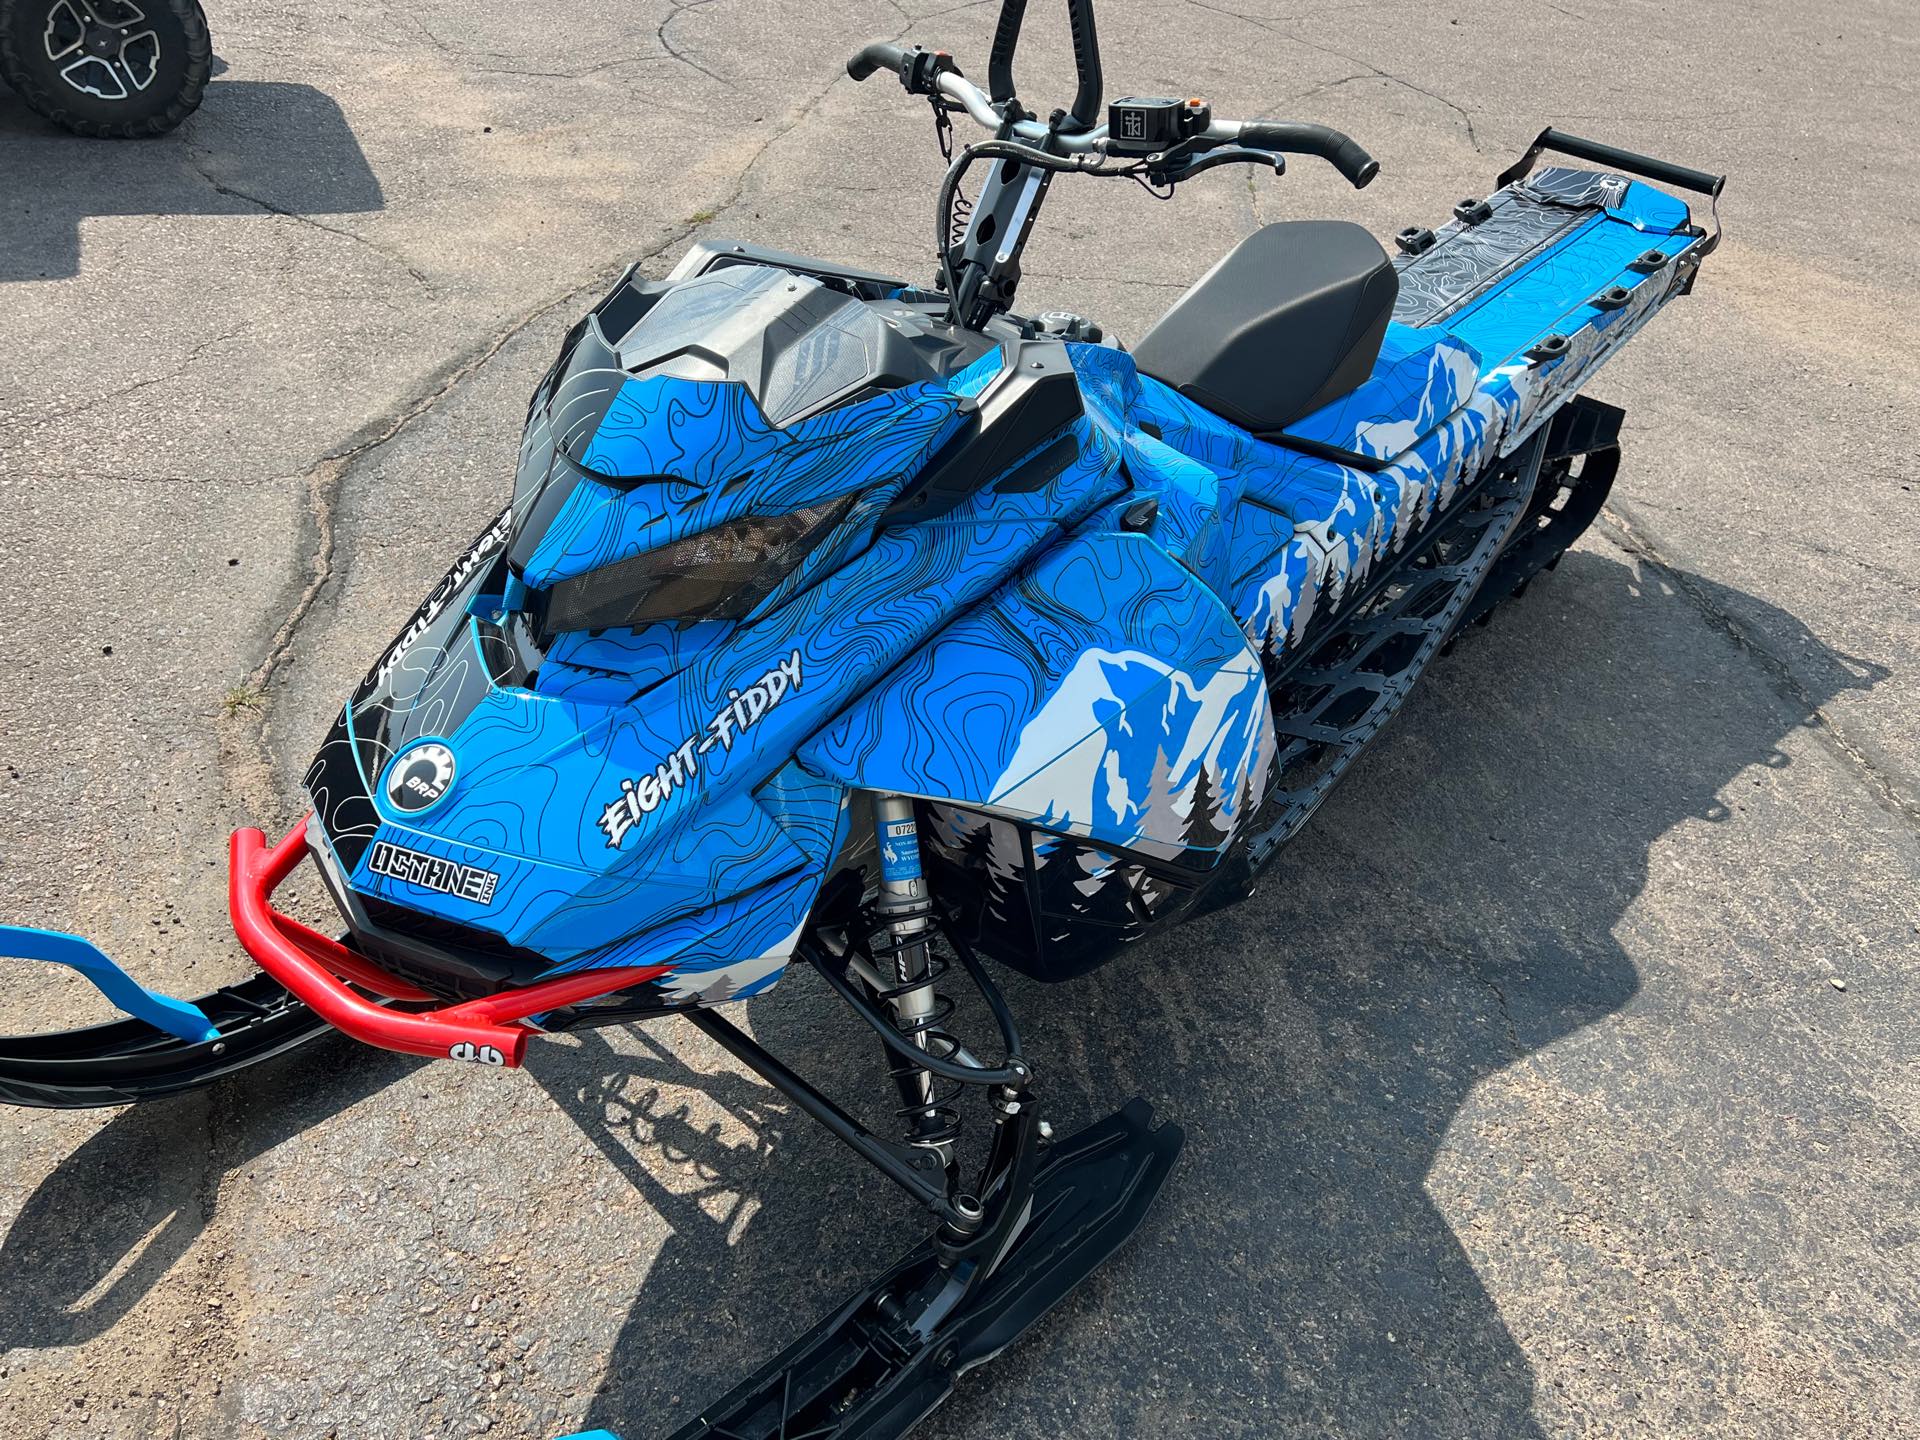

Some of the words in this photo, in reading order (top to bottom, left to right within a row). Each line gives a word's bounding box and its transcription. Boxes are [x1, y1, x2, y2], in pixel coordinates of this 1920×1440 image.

[405, 776, 439, 799] BRP
[369, 842, 487, 901] OCTANE
[481, 875, 497, 902] INK
